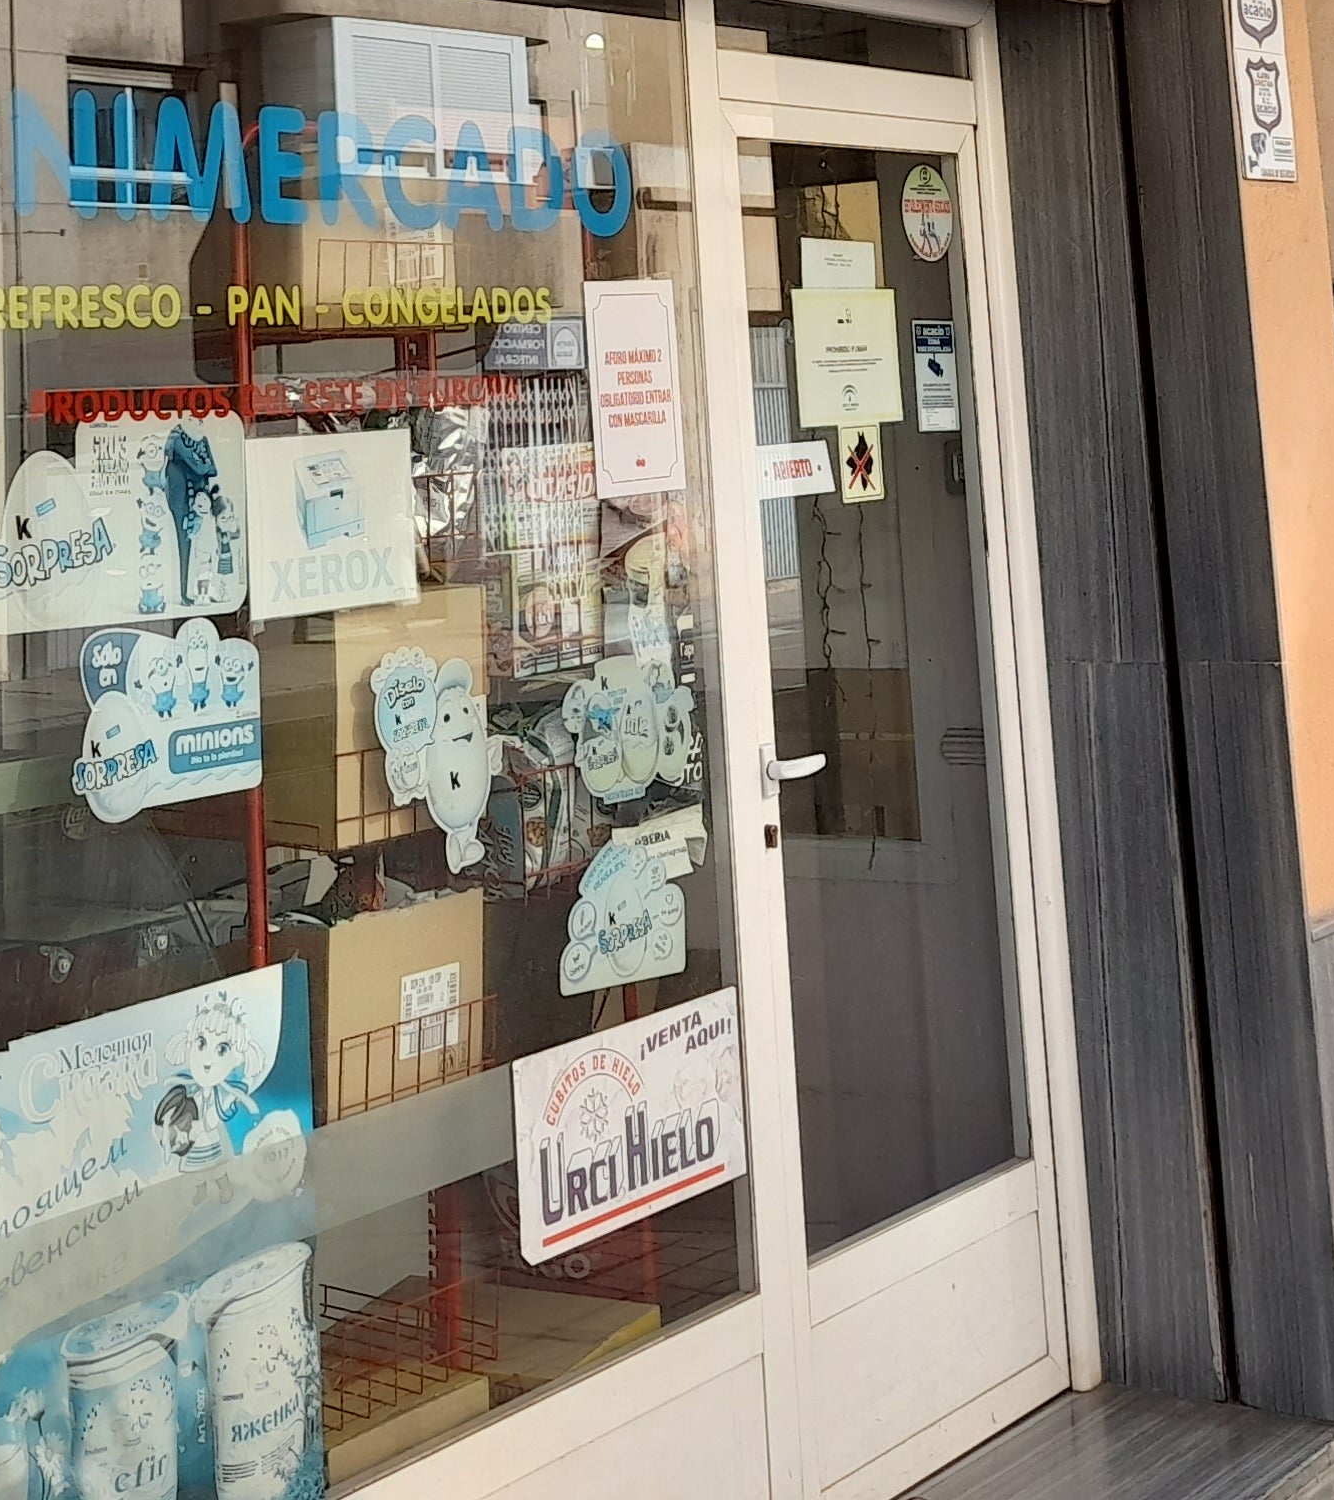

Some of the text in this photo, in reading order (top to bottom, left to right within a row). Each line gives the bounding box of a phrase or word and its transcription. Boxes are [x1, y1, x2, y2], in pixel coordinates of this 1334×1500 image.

[1244, 2, 1272, 19] acacio
[227, 284, 301, 327] PAN
[342, 285, 553, 326] CONGELADOS
[604, 347, 662, 366] AFORO MÁXIMO 2
[617, 369, 653, 386] PERSONAS
[33, 385, 231, 423] PRODUCTOS
[303, 379, 363, 409] ESTE
[600, 388, 672, 408] OBLIGATORIO ENTRAR
[608, 409, 667, 429] CON MASCARILLA
[772, 458, 813, 481] ABIERTO
[270, 546, 395, 603] XEROX
[99, 668, 118, 687] en
[384, 676, 425, 709] Díselo
[75, 739, 158, 791] SORPRESA
[56, 1031, 152, 1074] Молочная
[640, 1011, 702, 1061] ¡VENTA
[685, 1018, 732, 1055] AQUI!
[546, 1054, 642, 1127] CUBITOS DE HIELO
[539, 1104, 716, 1226] URCI HIELO
